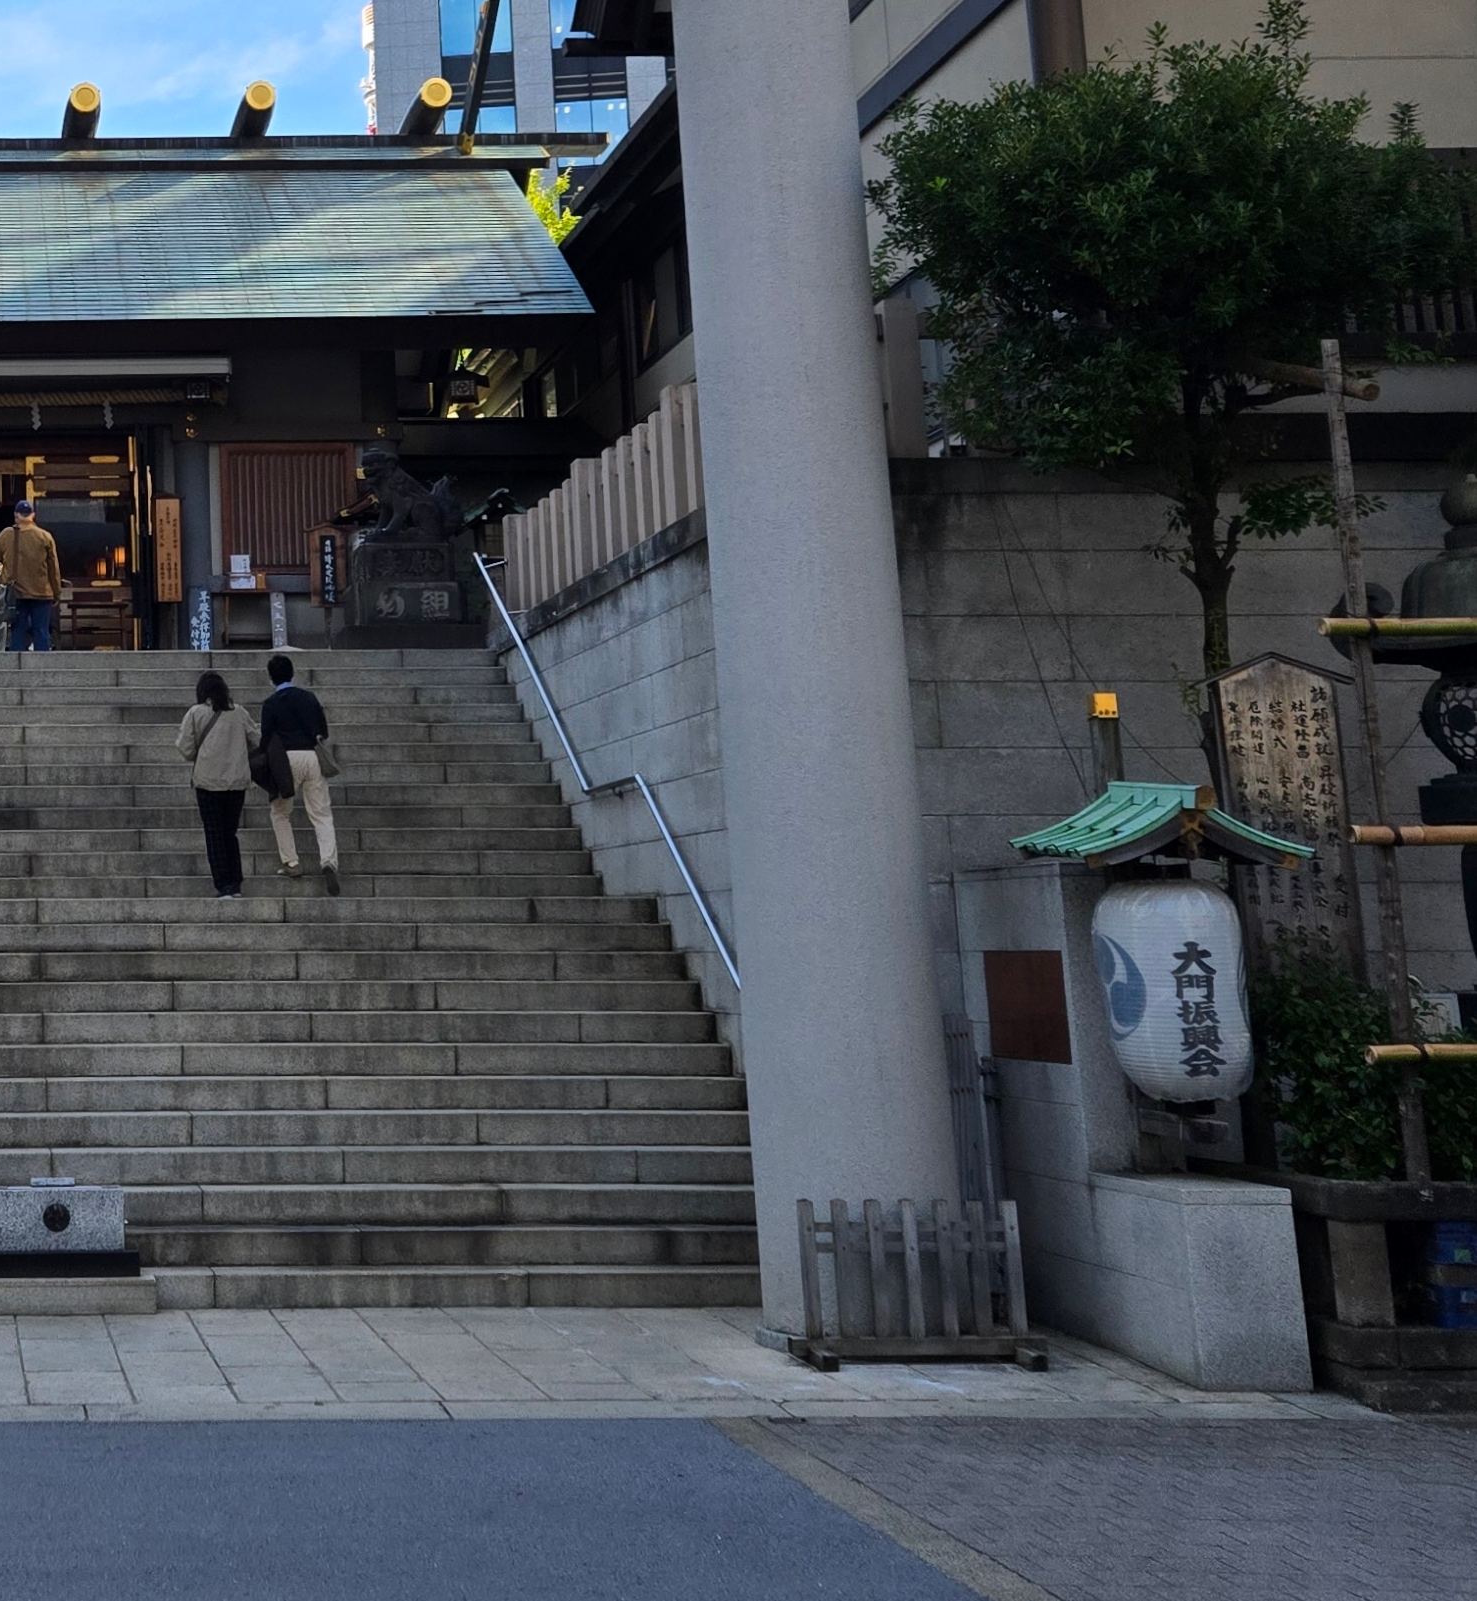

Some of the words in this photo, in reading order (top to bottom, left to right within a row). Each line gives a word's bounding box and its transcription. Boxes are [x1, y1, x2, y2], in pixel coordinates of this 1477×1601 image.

[1247, 700, 1266, 755] 厄除開運
[1268, 700, 1288, 750] 結婚式
[1170, 941, 1227, 1078] 大門振興会
